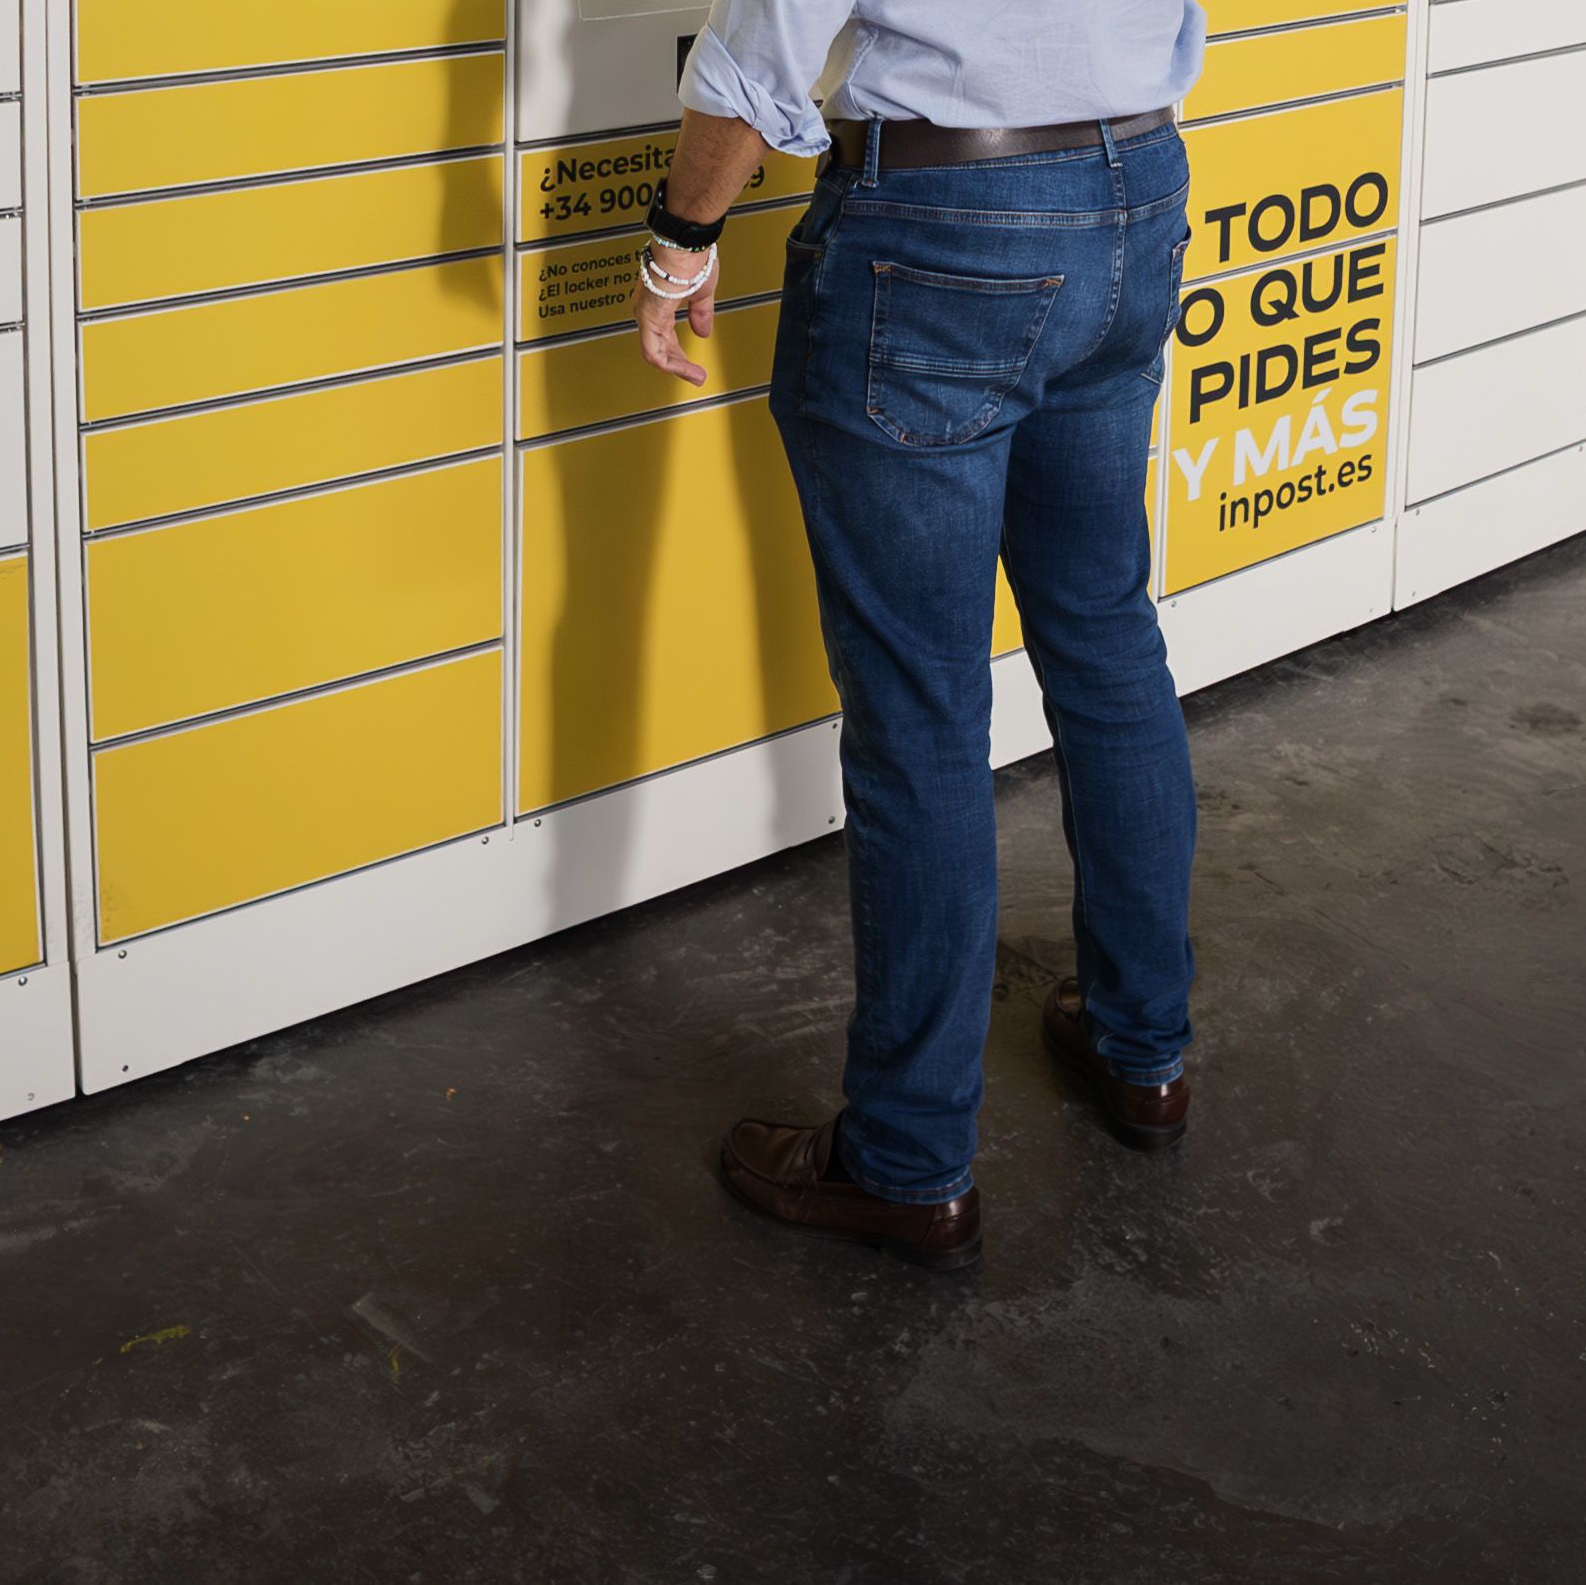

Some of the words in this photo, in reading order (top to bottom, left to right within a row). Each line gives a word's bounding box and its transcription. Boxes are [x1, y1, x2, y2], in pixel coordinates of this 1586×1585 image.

[539, 195, 592, 221] +34
[1204, 171, 1390, 263] TODO
[538, 264, 568, 282] ¿No
[571, 253, 632, 275] conoces
[538, 284, 560, 302] ¿El
[564, 275, 610, 296] locker
[613, 271, 632, 285] no
[538, 303, 566, 319] Usa
[569, 292, 626, 312] nuestro
[1249, 242, 1387, 328] QUE
[1189, 317, 1382, 425] PIDES
[1171, 436, 1220, 502] Y
[1232, 387, 1379, 487] MÁS
[1218, 453, 1373, 532] inpost.es
